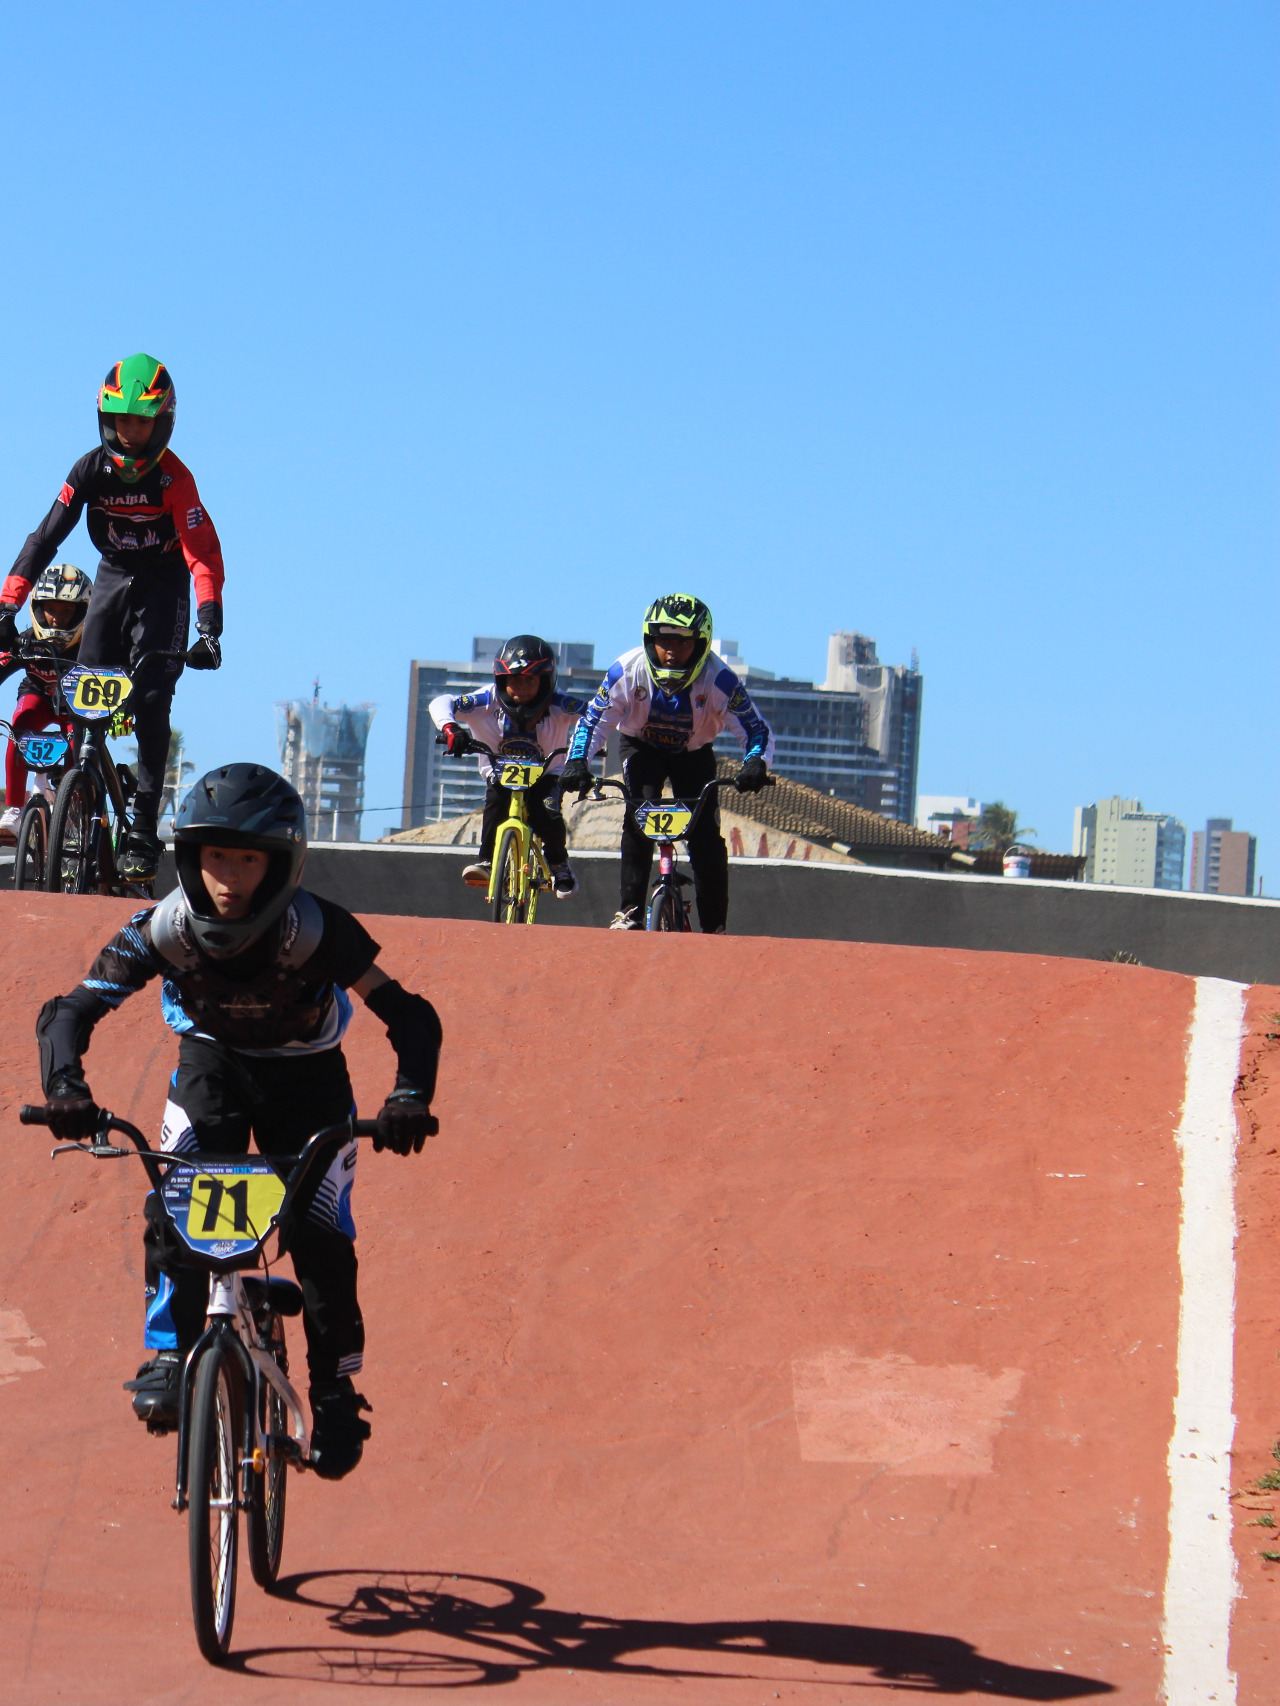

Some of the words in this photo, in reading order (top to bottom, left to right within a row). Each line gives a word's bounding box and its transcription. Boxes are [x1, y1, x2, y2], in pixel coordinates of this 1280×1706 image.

[81, 678, 122, 708] 69
[31, 741, 55, 761] 52
[505, 766, 531, 785] 21
[654, 813, 674, 834] 12
[198, 1180, 248, 1232] 71
